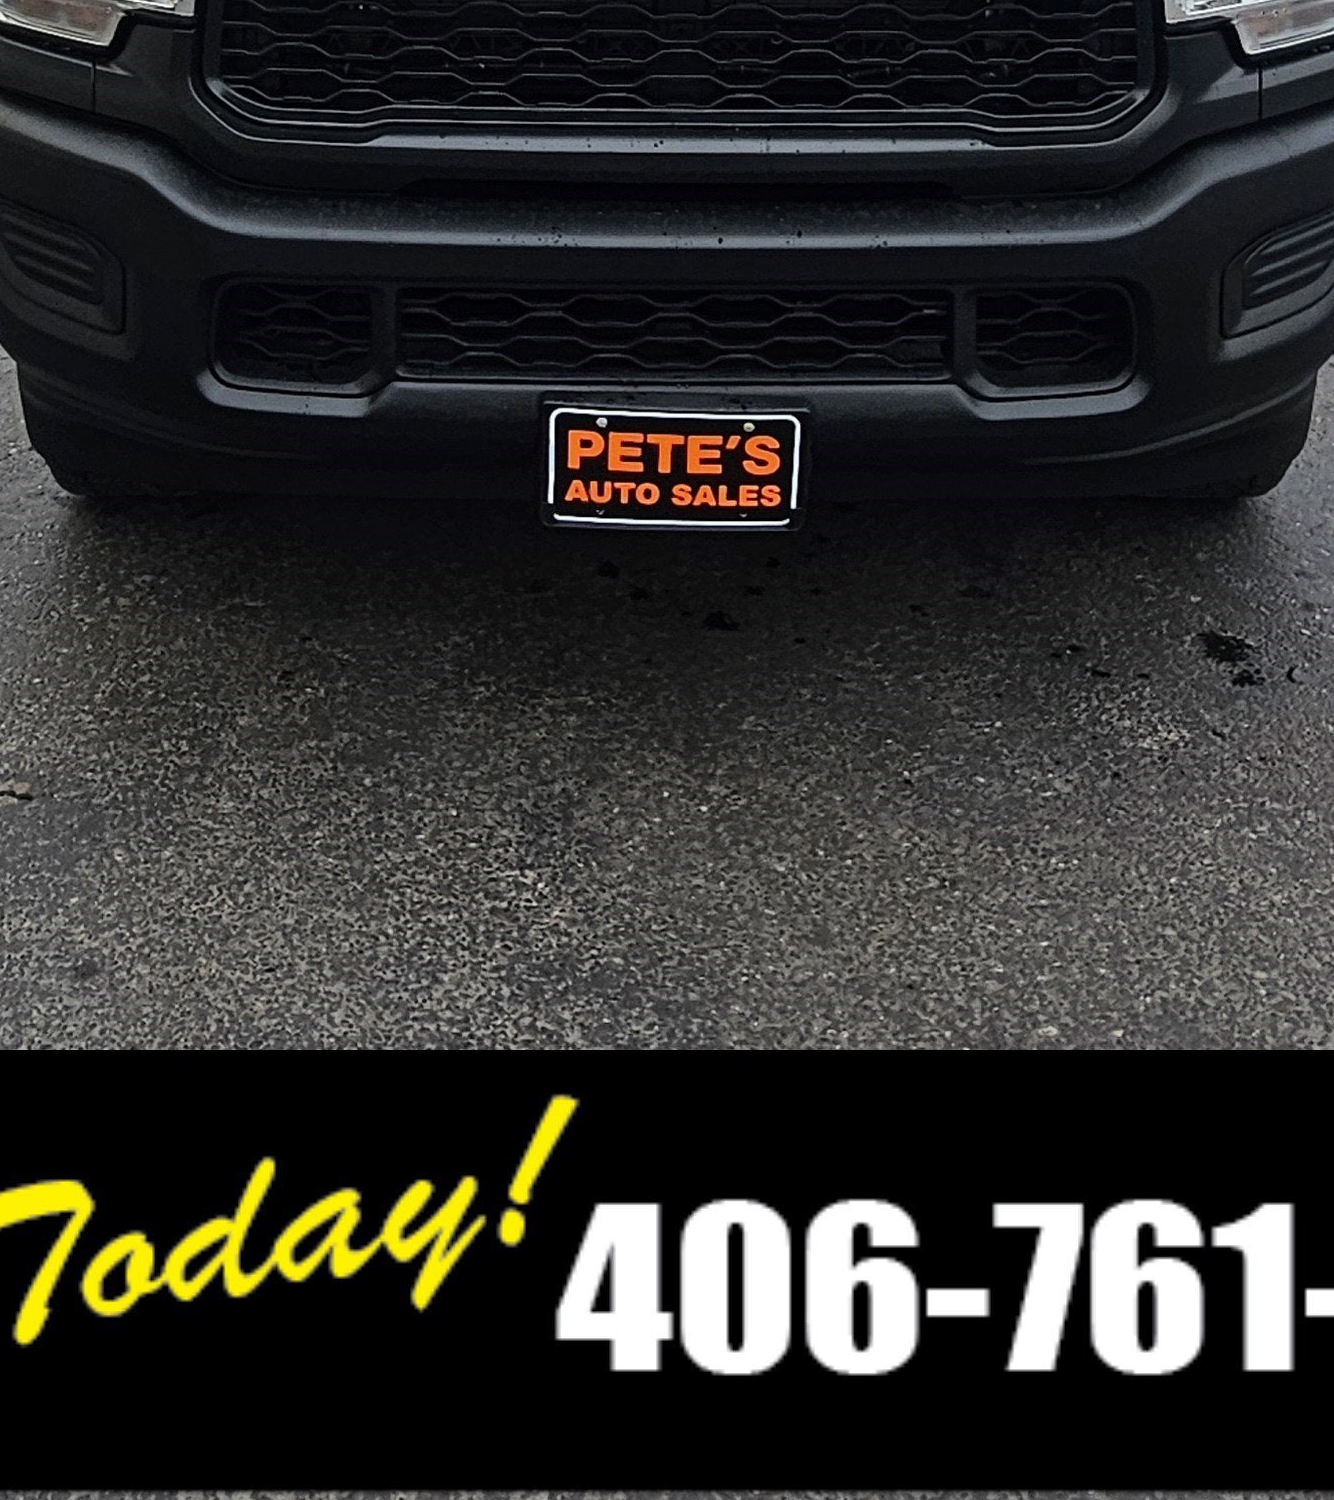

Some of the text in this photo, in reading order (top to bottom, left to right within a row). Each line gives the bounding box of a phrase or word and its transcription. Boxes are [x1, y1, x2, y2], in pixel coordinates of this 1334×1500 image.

[567, 429, 781, 476] PETE'S
[565, 480, 782, 507] AUTO SALES
